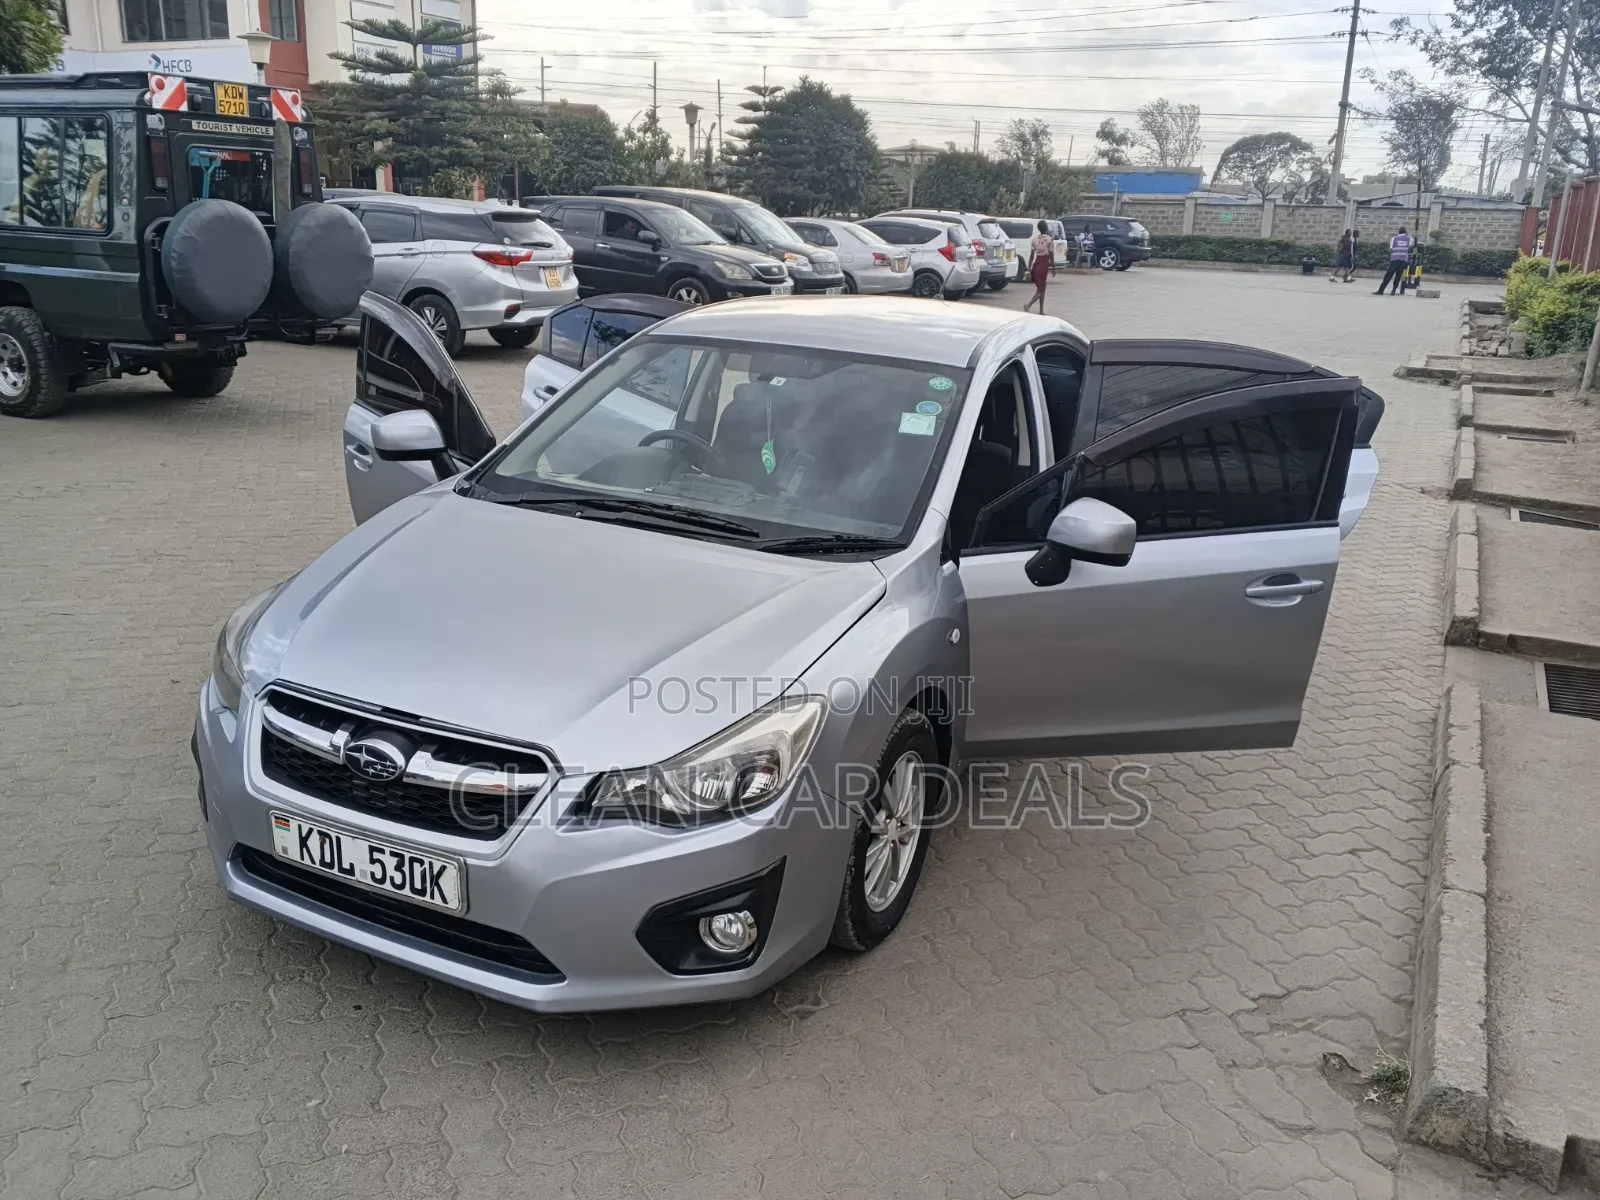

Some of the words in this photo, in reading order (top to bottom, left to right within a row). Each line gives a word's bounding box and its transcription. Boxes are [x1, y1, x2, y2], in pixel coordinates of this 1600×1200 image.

[161, 59, 192, 73] HFCB
[223, 85, 244, 100] KDW
[218, 100, 246, 116] 571Q
[195, 121, 233, 132] TOURIST
[235, 124, 271, 135] VEHICLE
[297, 823, 355, 878] KDL
[367, 844, 449, 905] 530K
